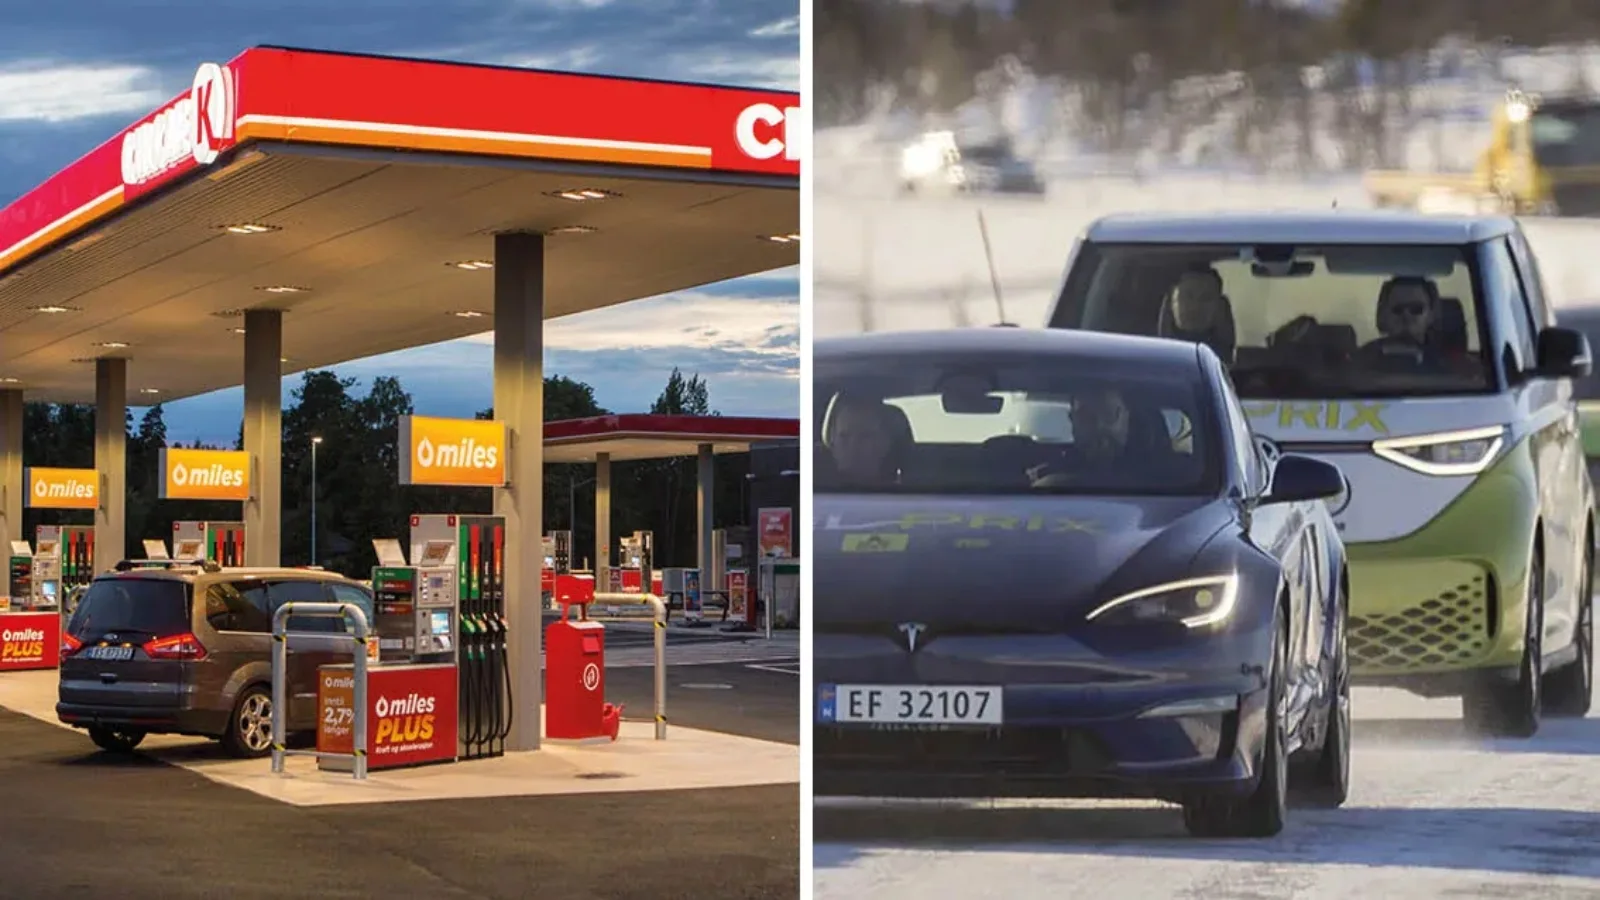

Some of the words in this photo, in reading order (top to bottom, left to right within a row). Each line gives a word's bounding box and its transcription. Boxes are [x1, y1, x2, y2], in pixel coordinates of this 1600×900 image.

[436, 437, 498, 468] miles
[190, 464, 244, 486] miles
[48, 480, 94, 498] miles
[12, 628, 45, 642] miles
[2, 641, 43, 657] PLUS
[332, 677, 355, 688] mile
[389, 693, 436, 716] miles
[849, 690, 882, 718] EF
[898, 690, 990, 719] 32107
[375, 714, 436, 744] PLUS
